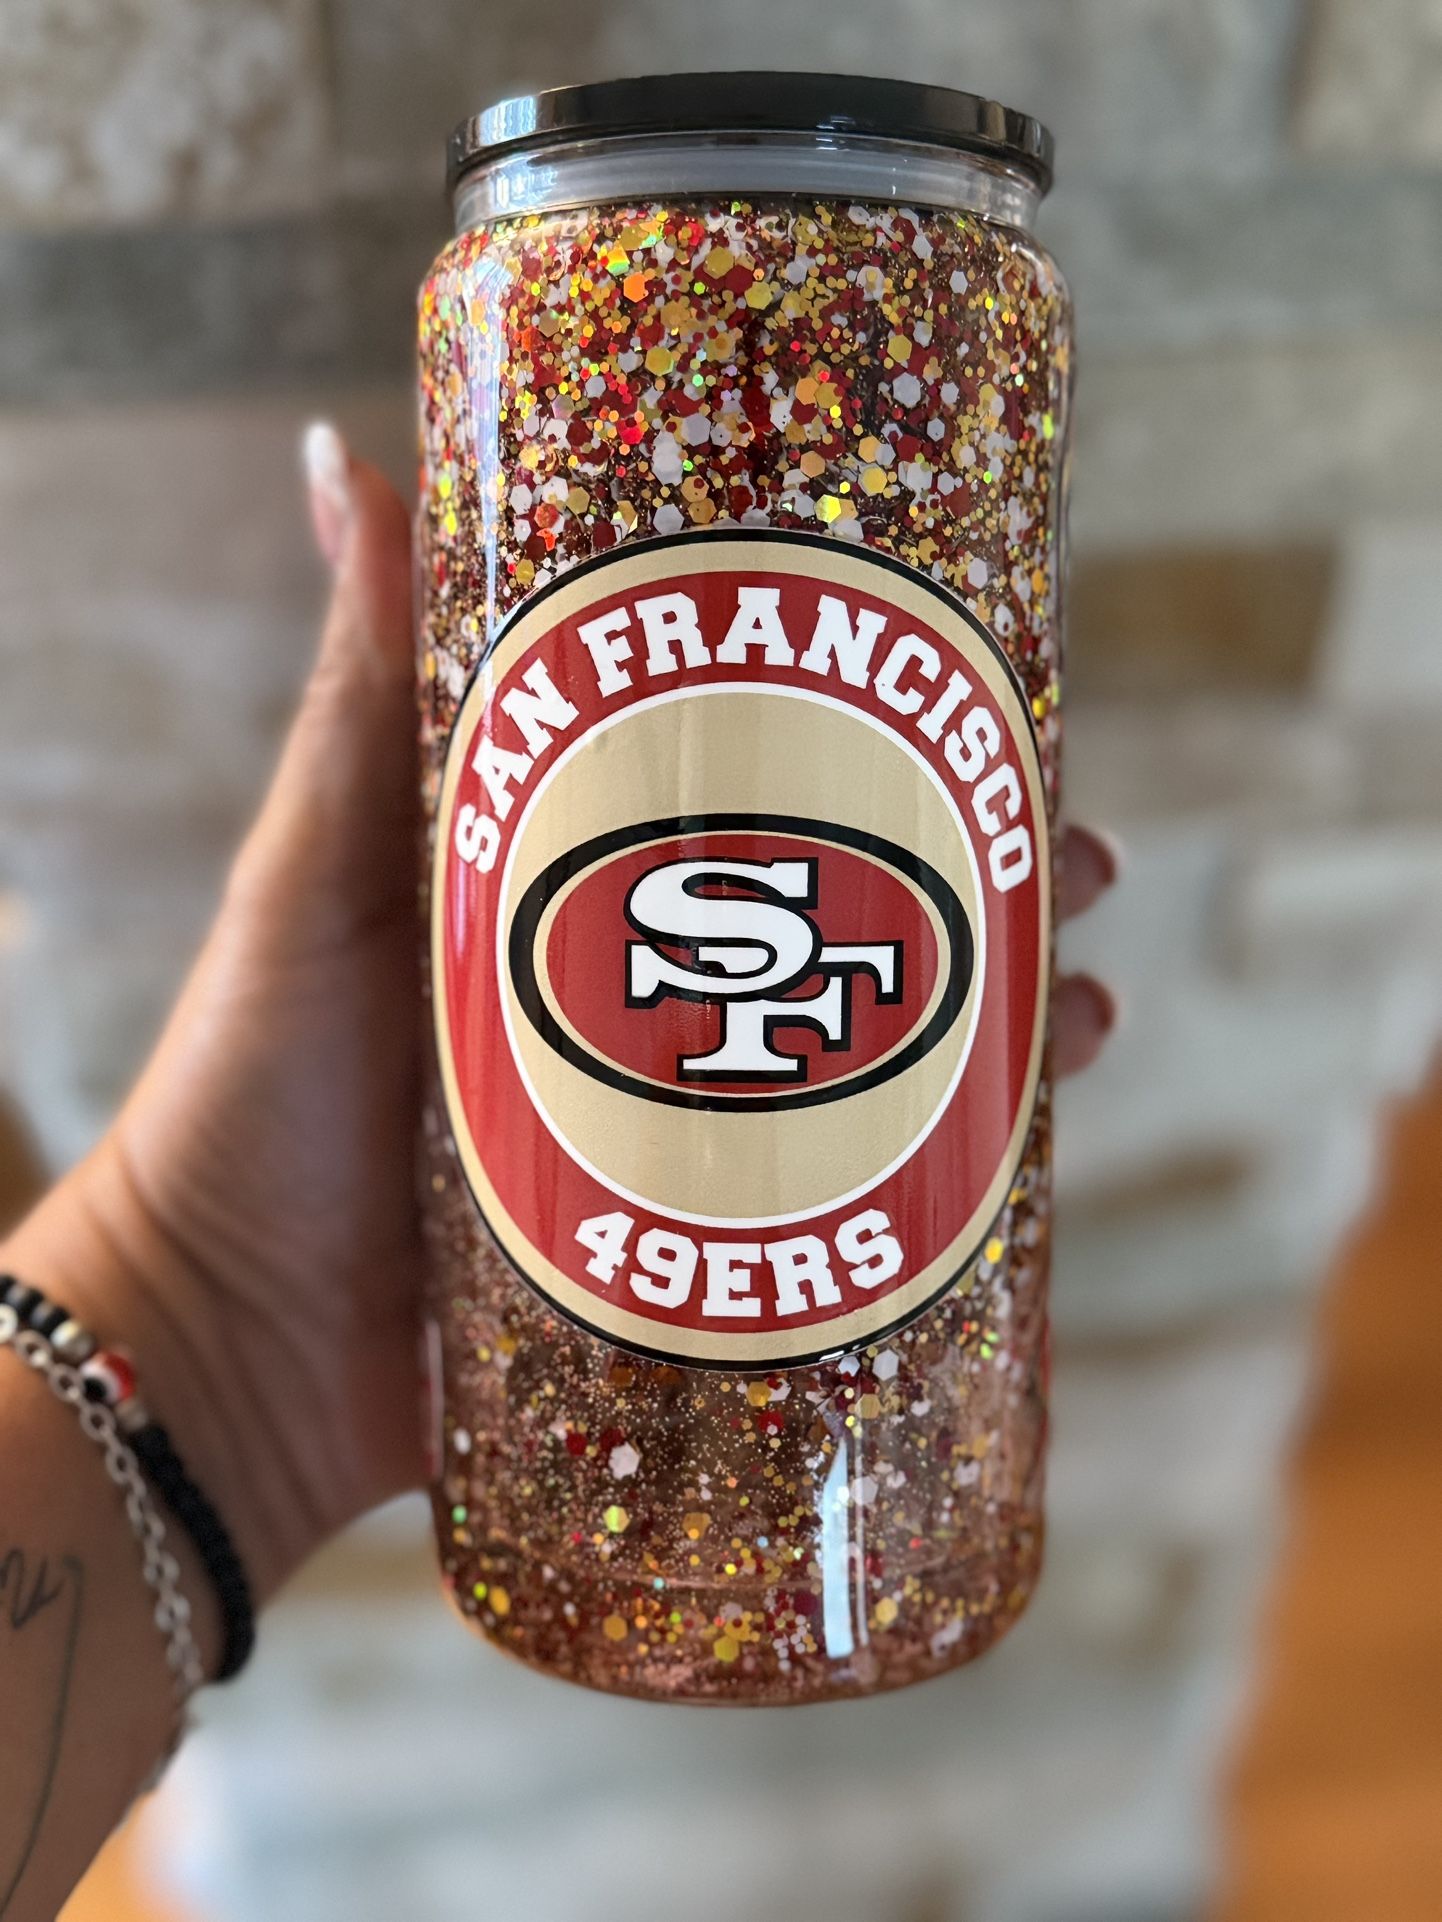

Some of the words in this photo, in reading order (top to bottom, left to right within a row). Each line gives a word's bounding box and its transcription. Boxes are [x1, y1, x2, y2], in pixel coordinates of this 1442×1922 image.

[455, 657, 579, 873] SAN
[577, 586, 1032, 892] FRANCISCO
[625, 858, 903, 1082] SF
[574, 1208, 904, 1317] 49ERS
